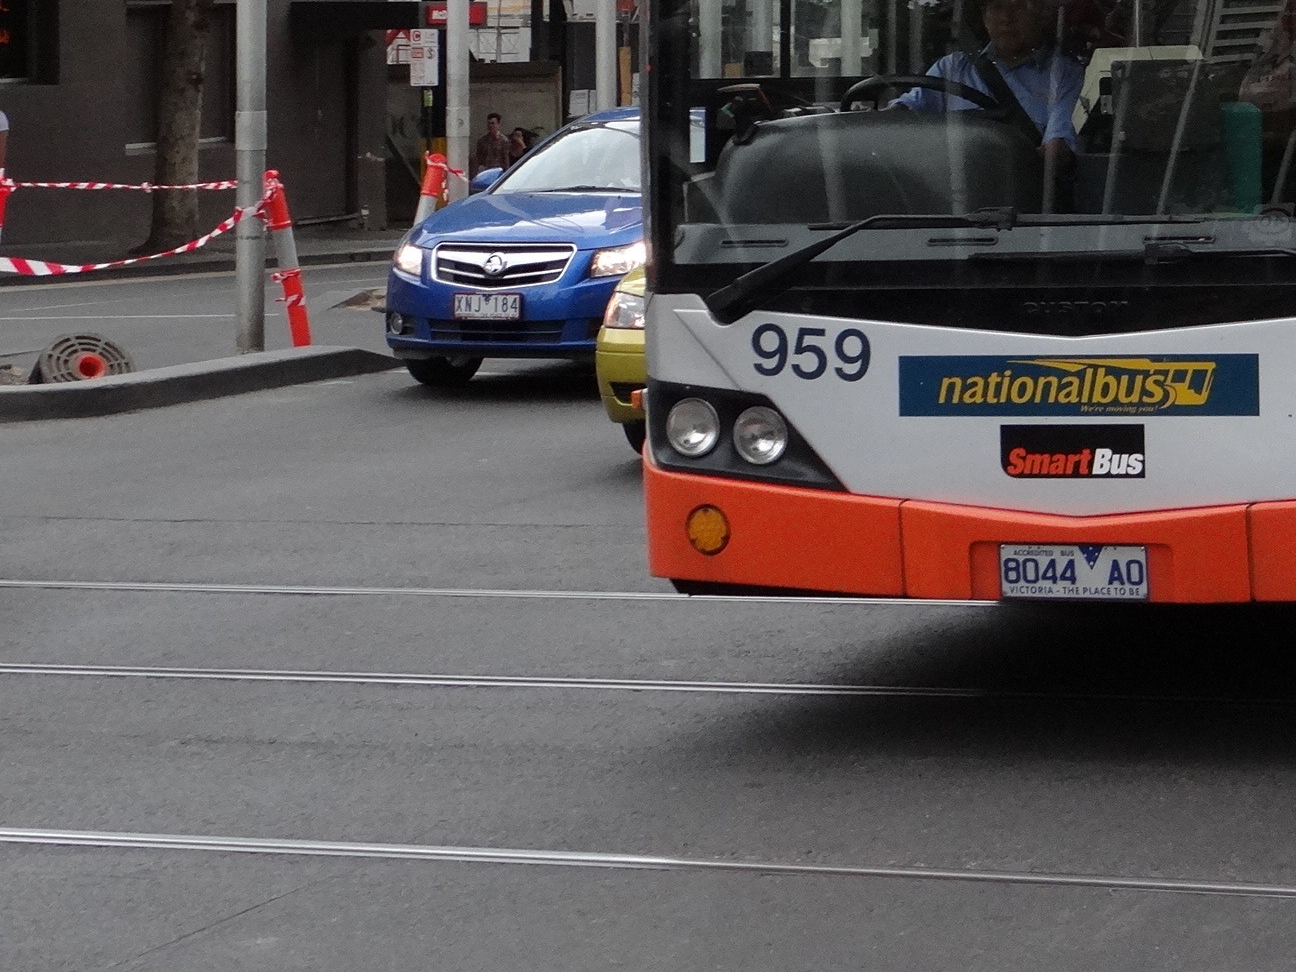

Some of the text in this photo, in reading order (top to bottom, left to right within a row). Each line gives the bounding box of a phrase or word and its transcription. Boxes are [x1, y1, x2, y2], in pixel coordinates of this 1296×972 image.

[456, 296, 517, 313] XNJ 184
[751, 324, 871, 382] 959
[938, 368, 1165, 405] nationalbus
[1105, 406, 1136, 414] moving
[1003, 557, 1077, 585] 8044
[1009, 586, 1054, 595] VICTORIA
[1062, 586, 1079, 595] THE
[1083, 586, 1111, 595] PLACE
[1114, 587, 1126, 596] TO
[1128, 587, 1140, 596] BE
